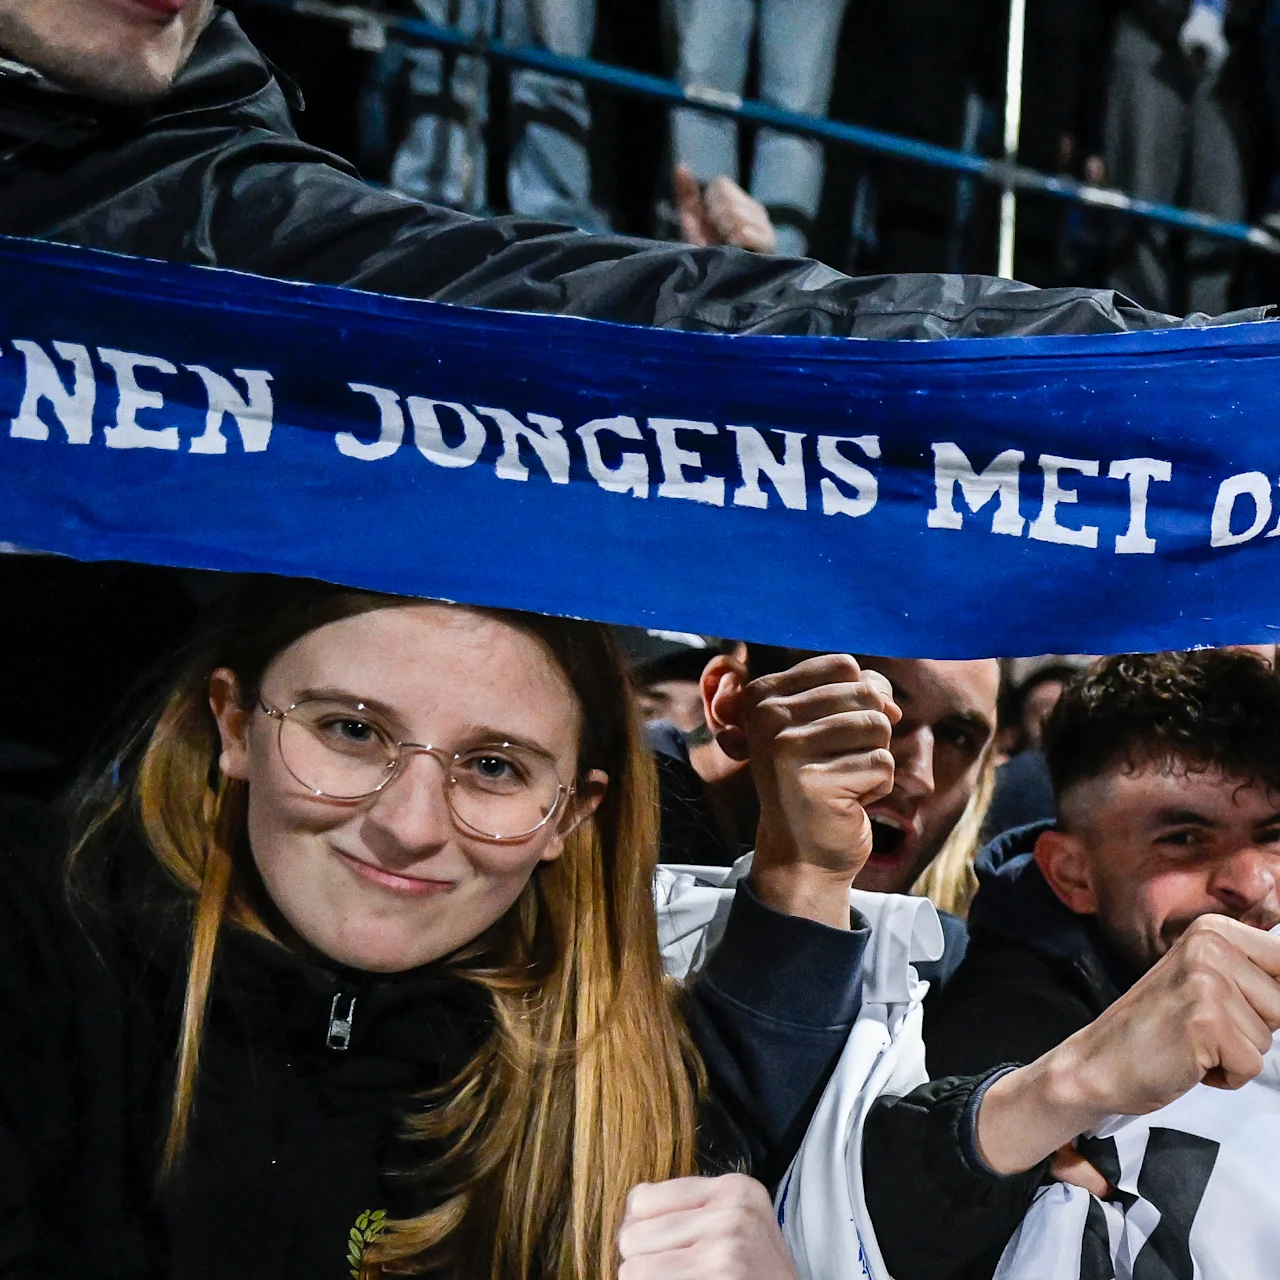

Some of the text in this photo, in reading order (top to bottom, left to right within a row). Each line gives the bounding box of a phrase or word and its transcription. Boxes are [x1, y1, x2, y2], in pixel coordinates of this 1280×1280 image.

[0, 338, 274, 454] NEN
[335, 382, 882, 519] JONGENS
[926, 441, 1172, 555] MET
